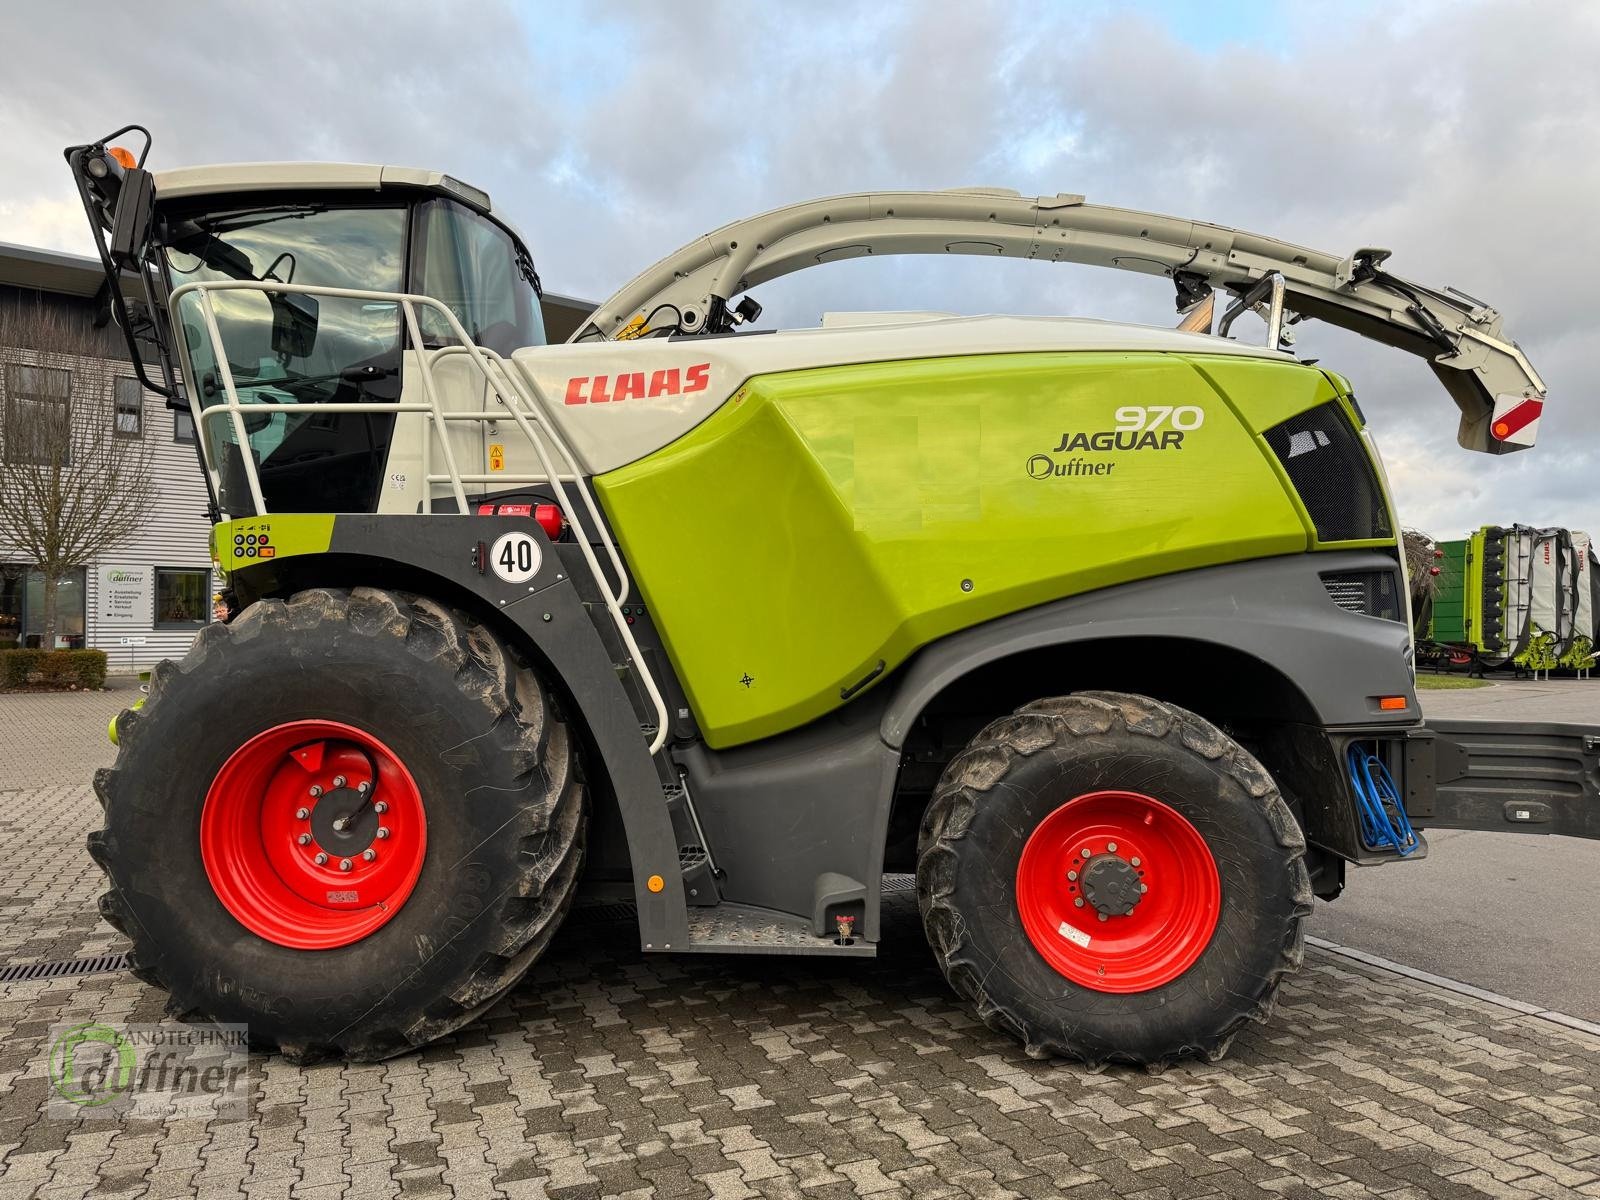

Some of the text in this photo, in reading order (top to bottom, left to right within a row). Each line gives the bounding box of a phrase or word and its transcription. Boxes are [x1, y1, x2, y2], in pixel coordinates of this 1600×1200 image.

[564, 362, 711, 405] CLAAS
[1114, 405, 1205, 432] 970
[1053, 431, 1185, 453] JAGUAR
[1026, 453, 1115, 480] Duffner
[499, 540, 531, 573] 40
